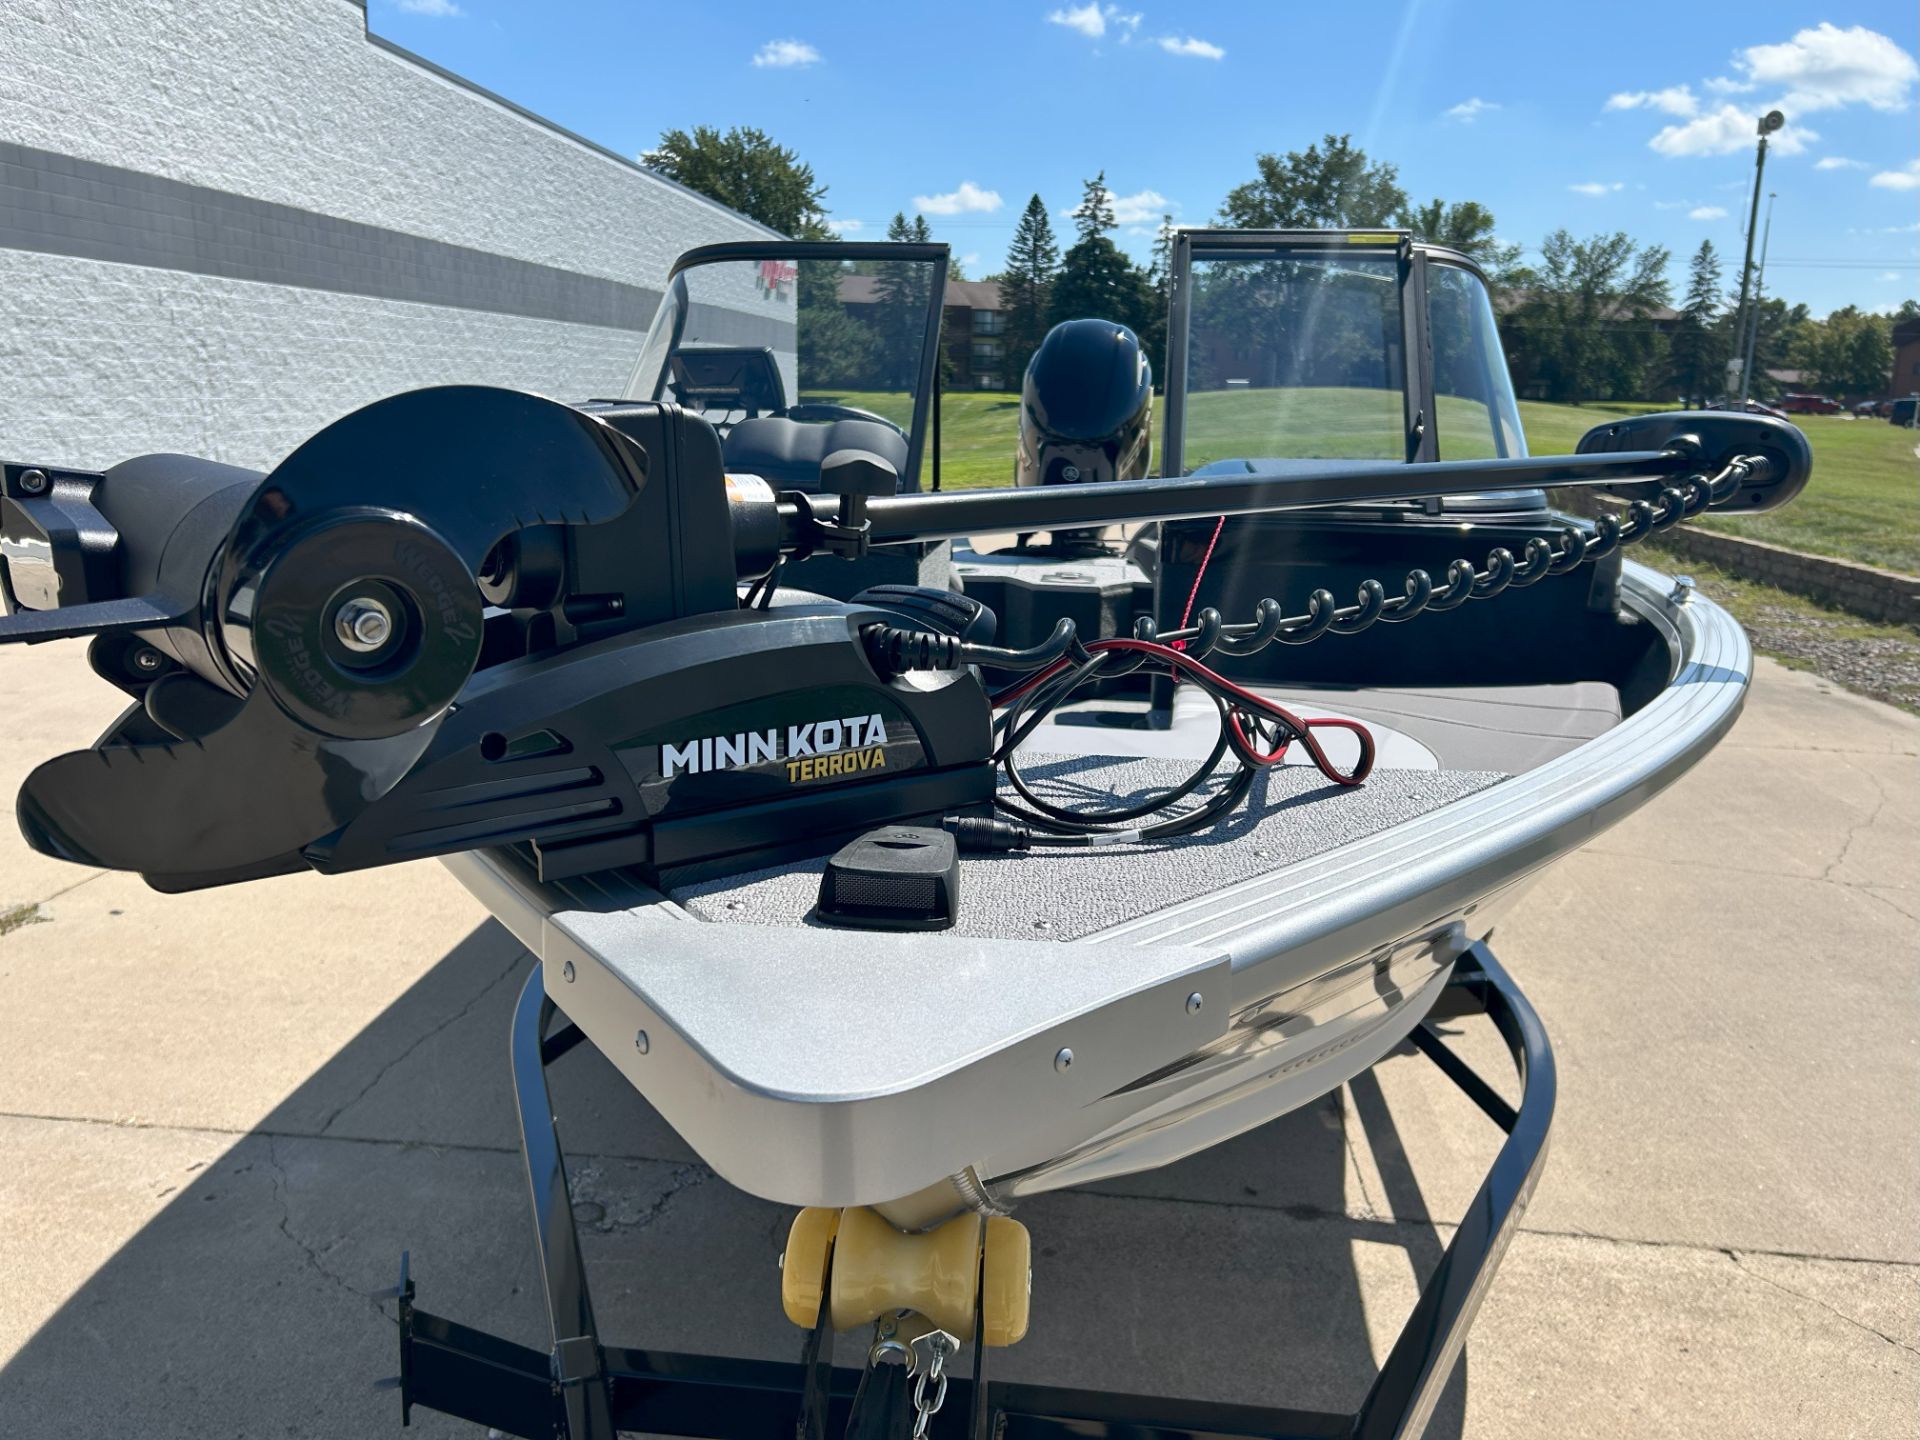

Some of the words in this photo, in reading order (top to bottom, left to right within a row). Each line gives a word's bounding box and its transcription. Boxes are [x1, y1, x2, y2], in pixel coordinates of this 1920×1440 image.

[661, 728, 778, 778] MINN
[788, 713, 888, 758] KOTA
[786, 748, 886, 783] TERROVA
